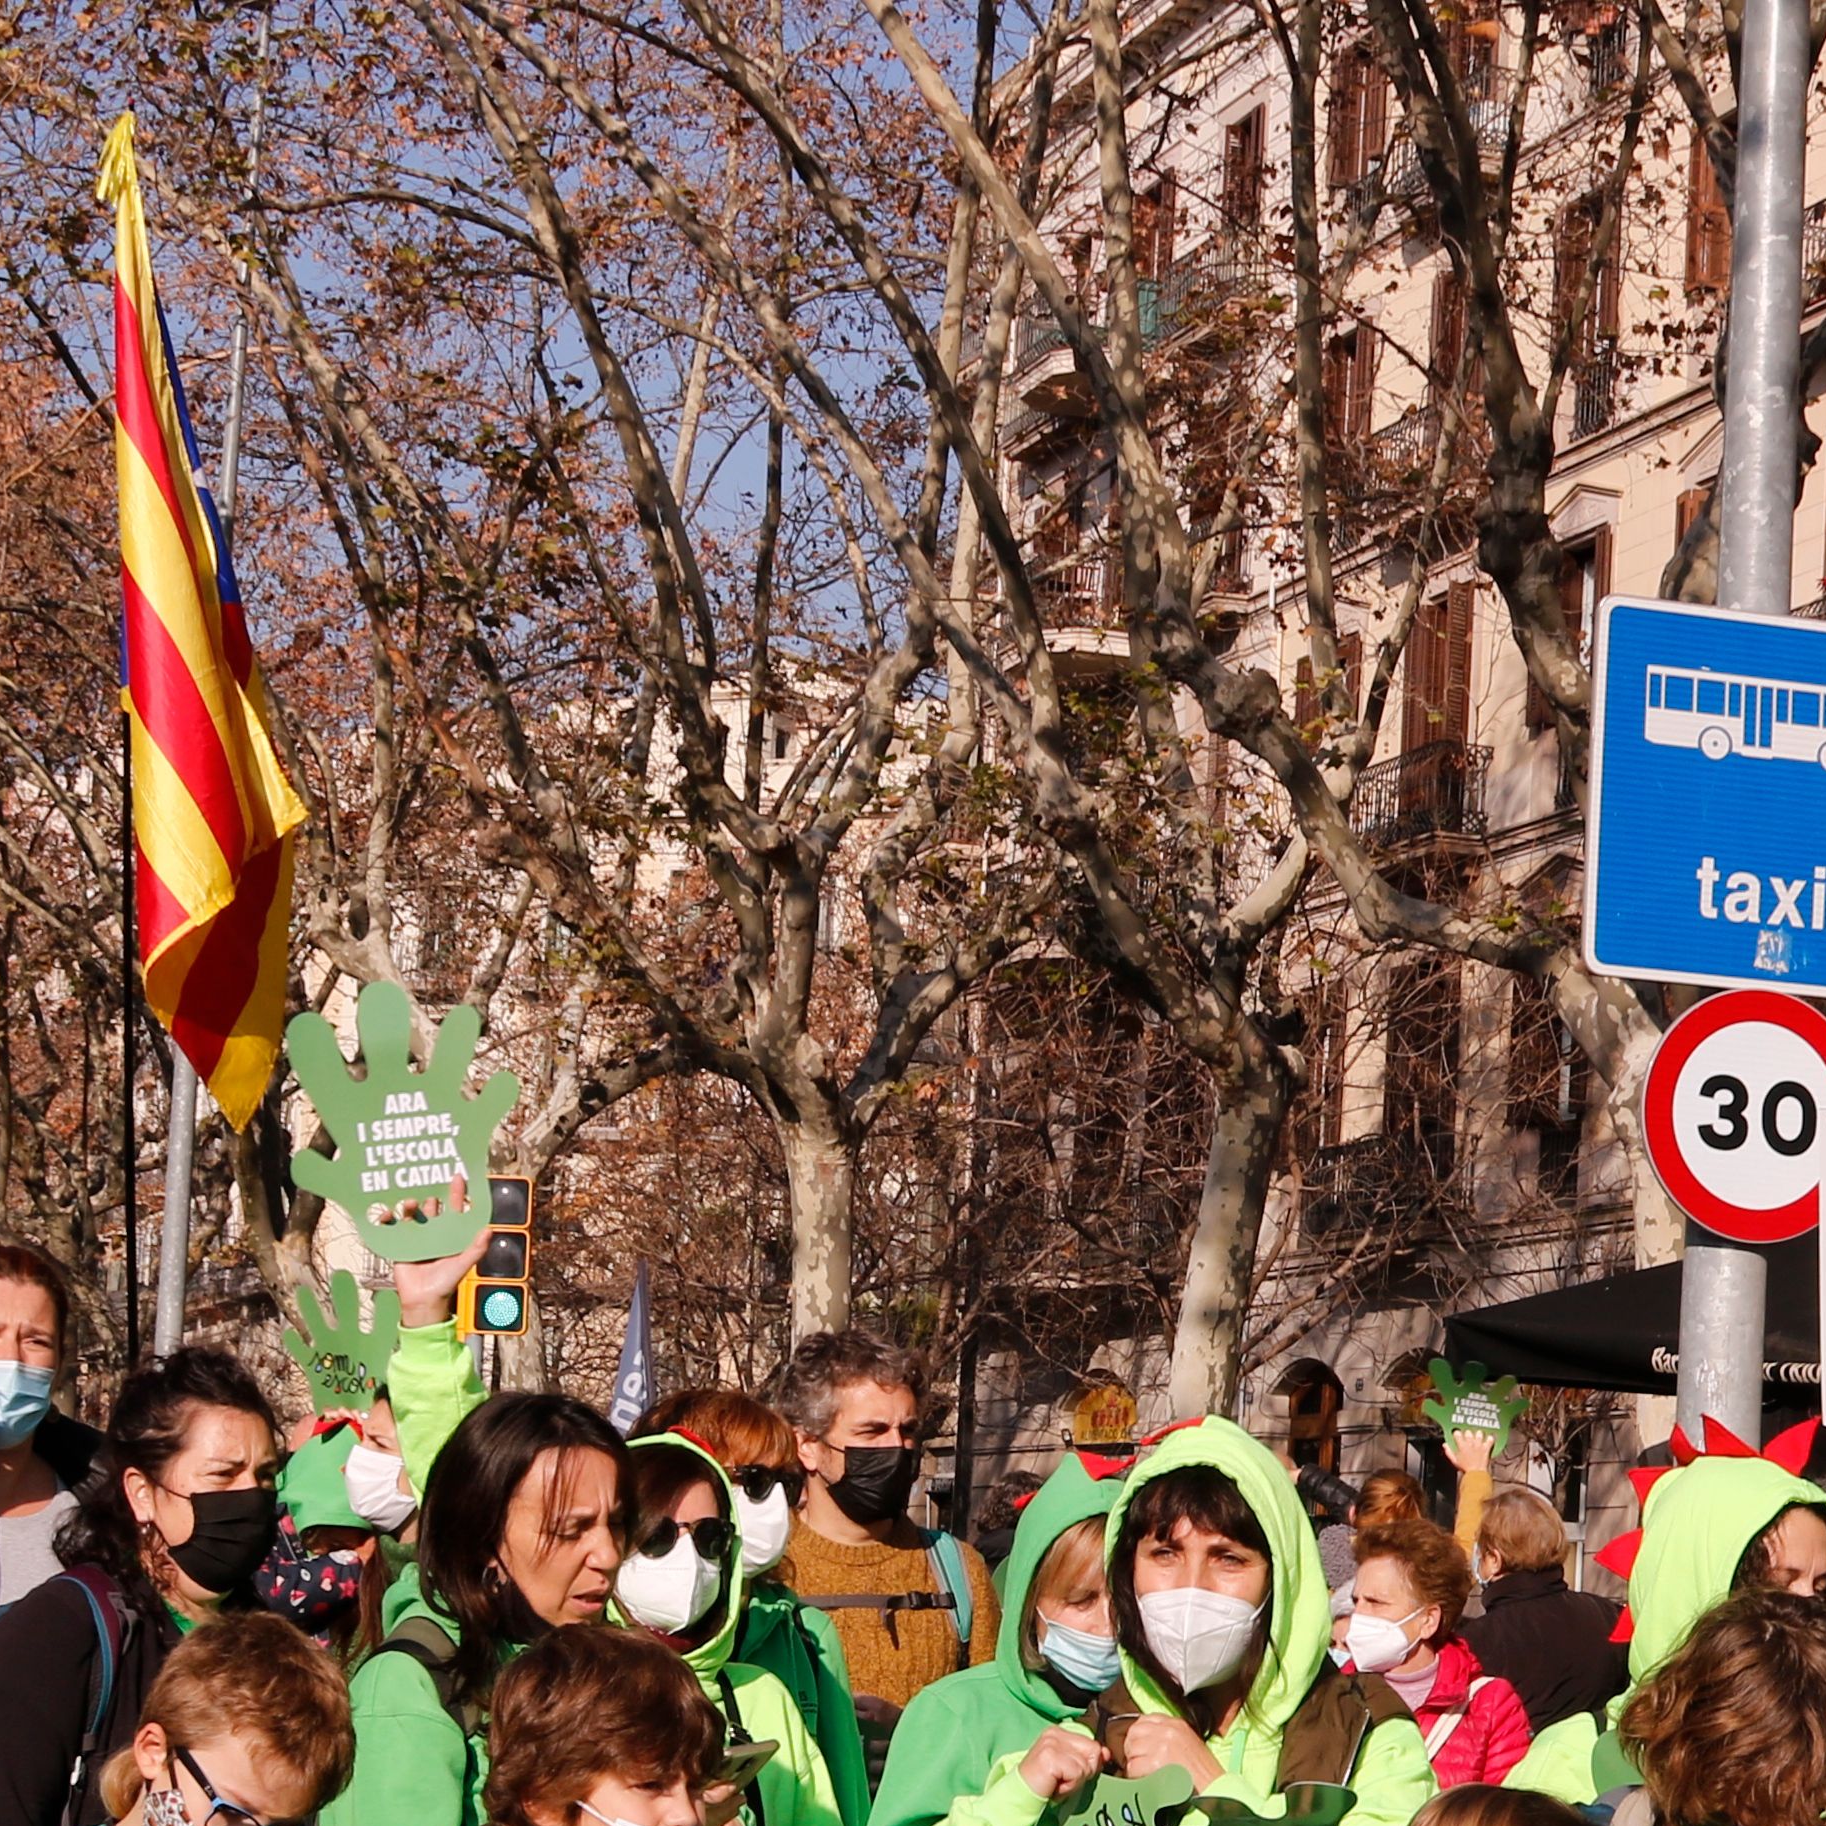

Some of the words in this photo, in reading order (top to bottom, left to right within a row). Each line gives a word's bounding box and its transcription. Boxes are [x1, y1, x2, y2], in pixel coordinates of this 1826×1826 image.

[384, 1091, 428, 1115] ARA
[1696, 1074, 1819, 1156] 30
[357, 1122, 366, 1142] I
[372, 1113, 460, 1142] SEMPRE,
[366, 1137, 457, 1167] L'ESCOLA
[360, 1171, 389, 1193] EN
[395, 1157, 469, 1188] CATALÀ
[308, 1351, 356, 1376] som
